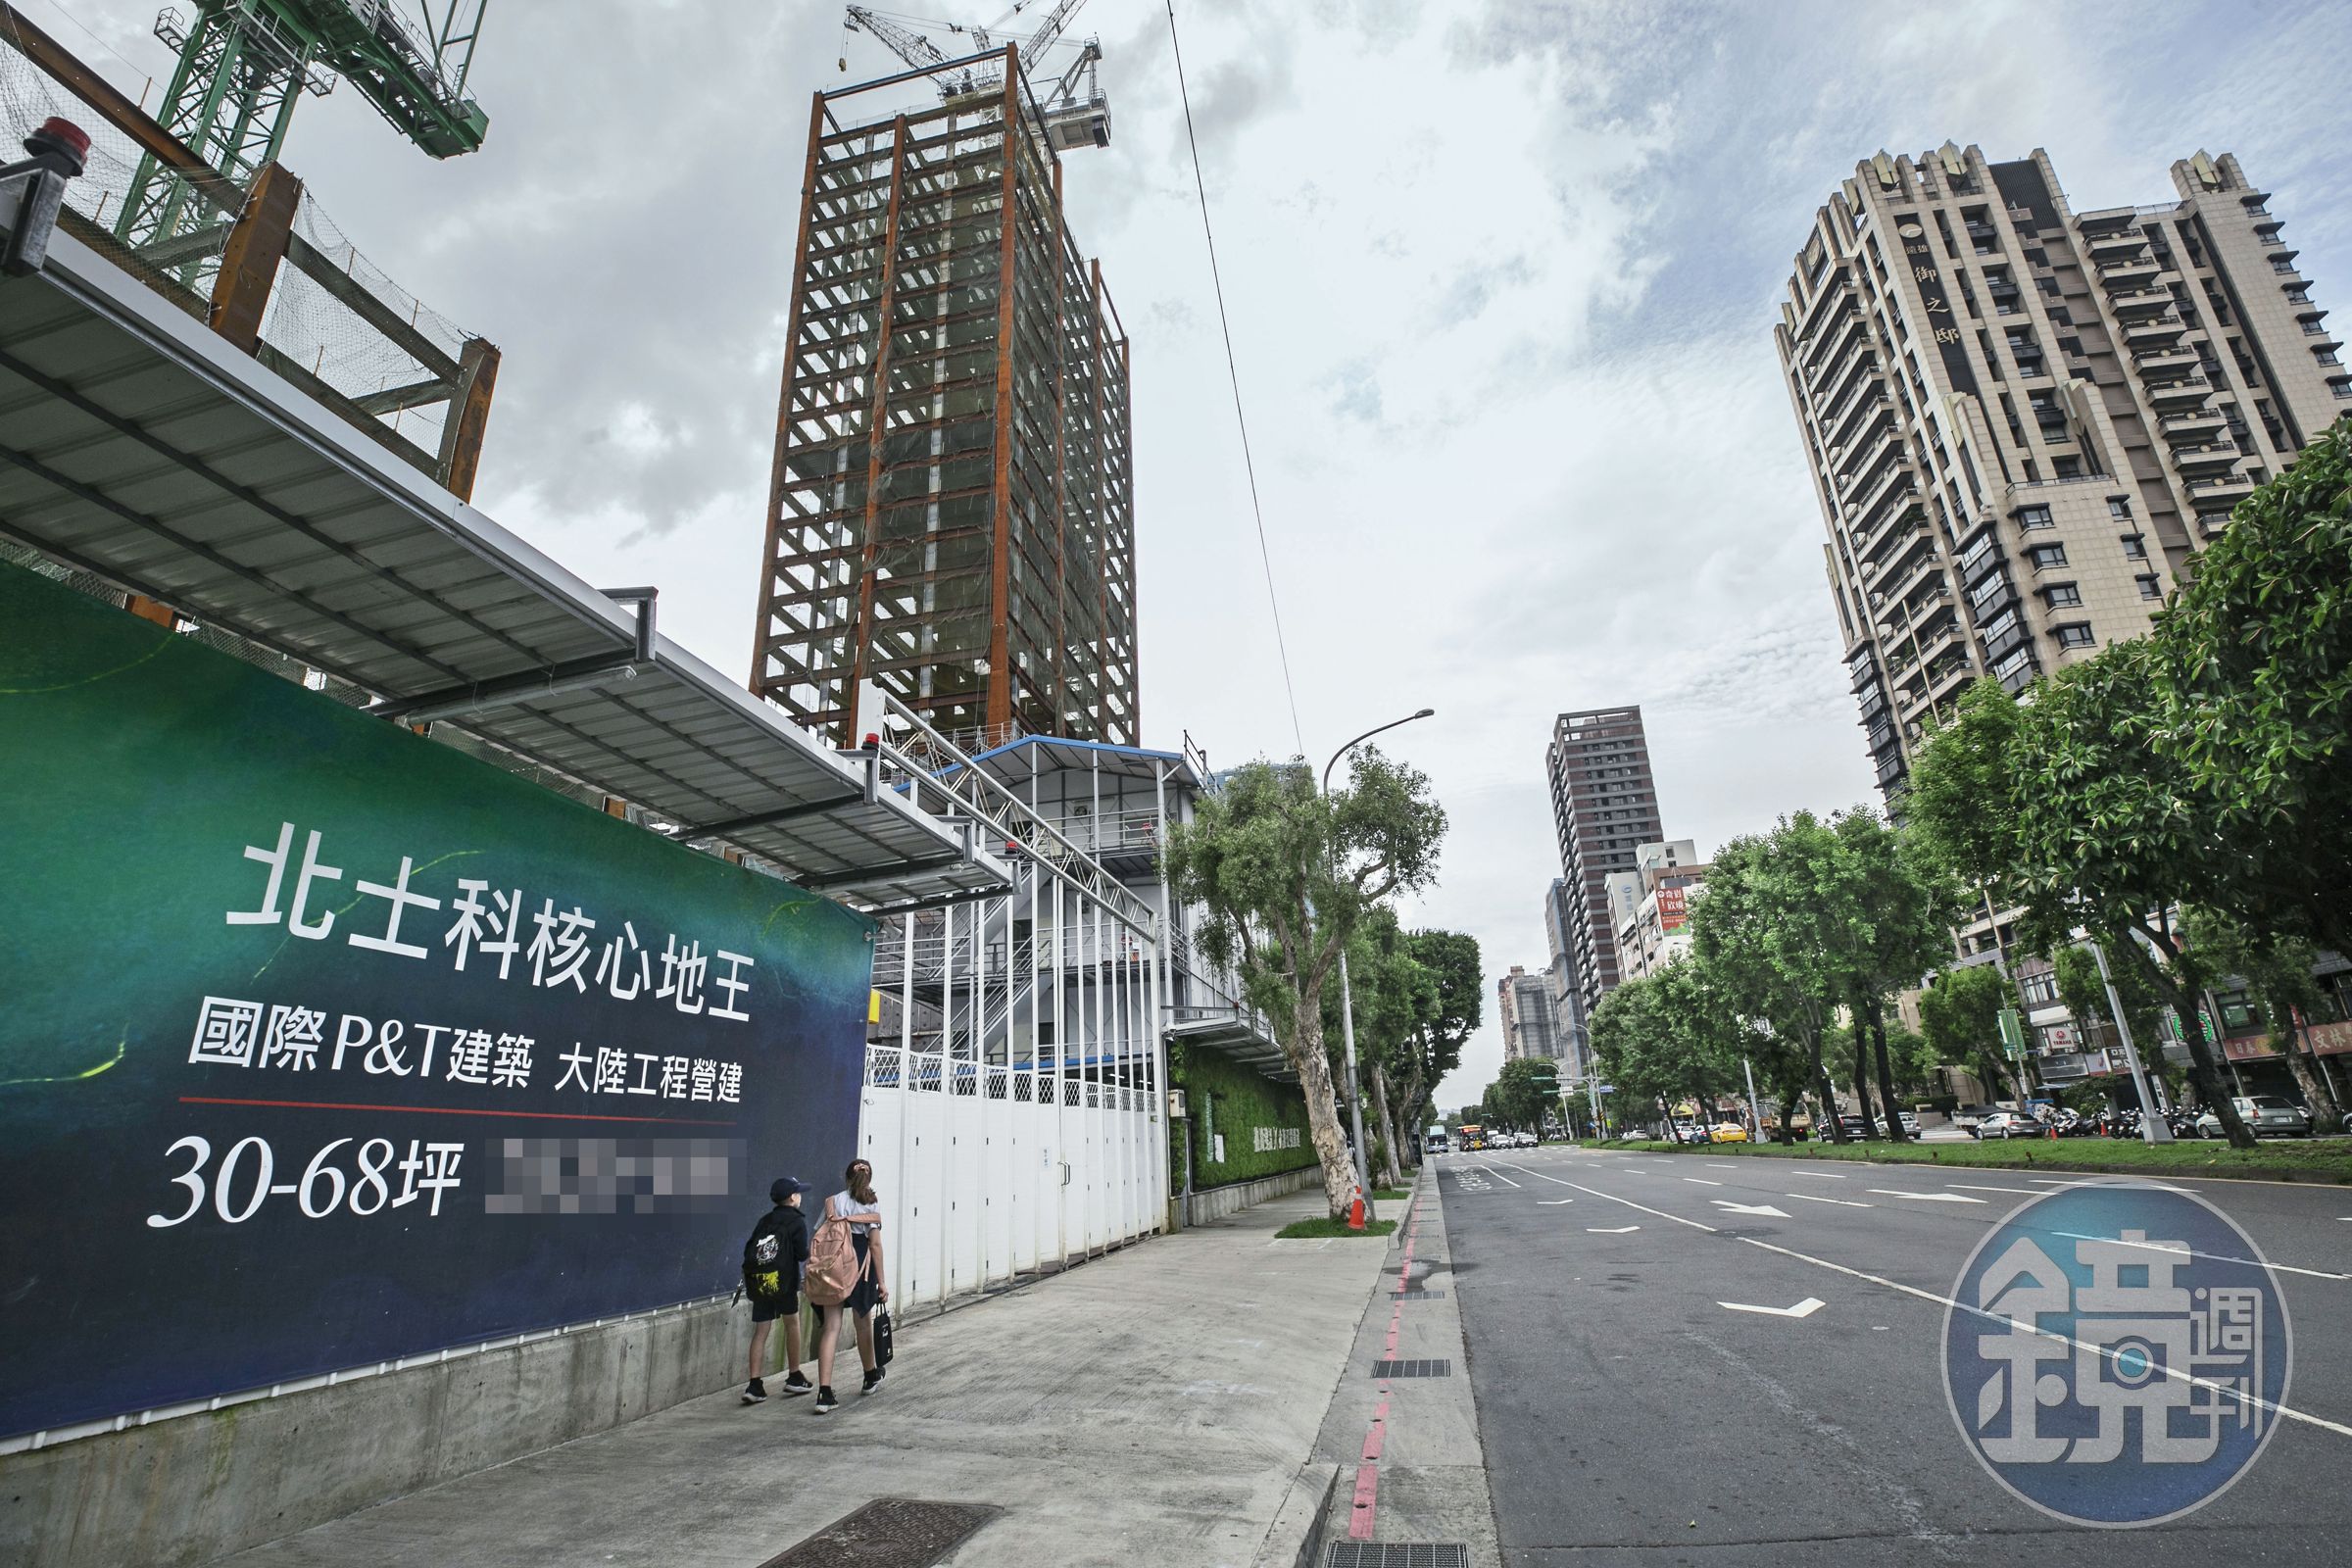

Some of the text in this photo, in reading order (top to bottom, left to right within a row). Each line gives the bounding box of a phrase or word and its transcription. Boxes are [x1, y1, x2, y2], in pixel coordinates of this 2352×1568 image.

[1915, 266, 1960, 345] 御之邸
[225, 821, 756, 1022] 北士科核心地王
[554, 1042, 743, 1104] 大陸工程營建
[147, 1135, 466, 1228] 30-68坪
